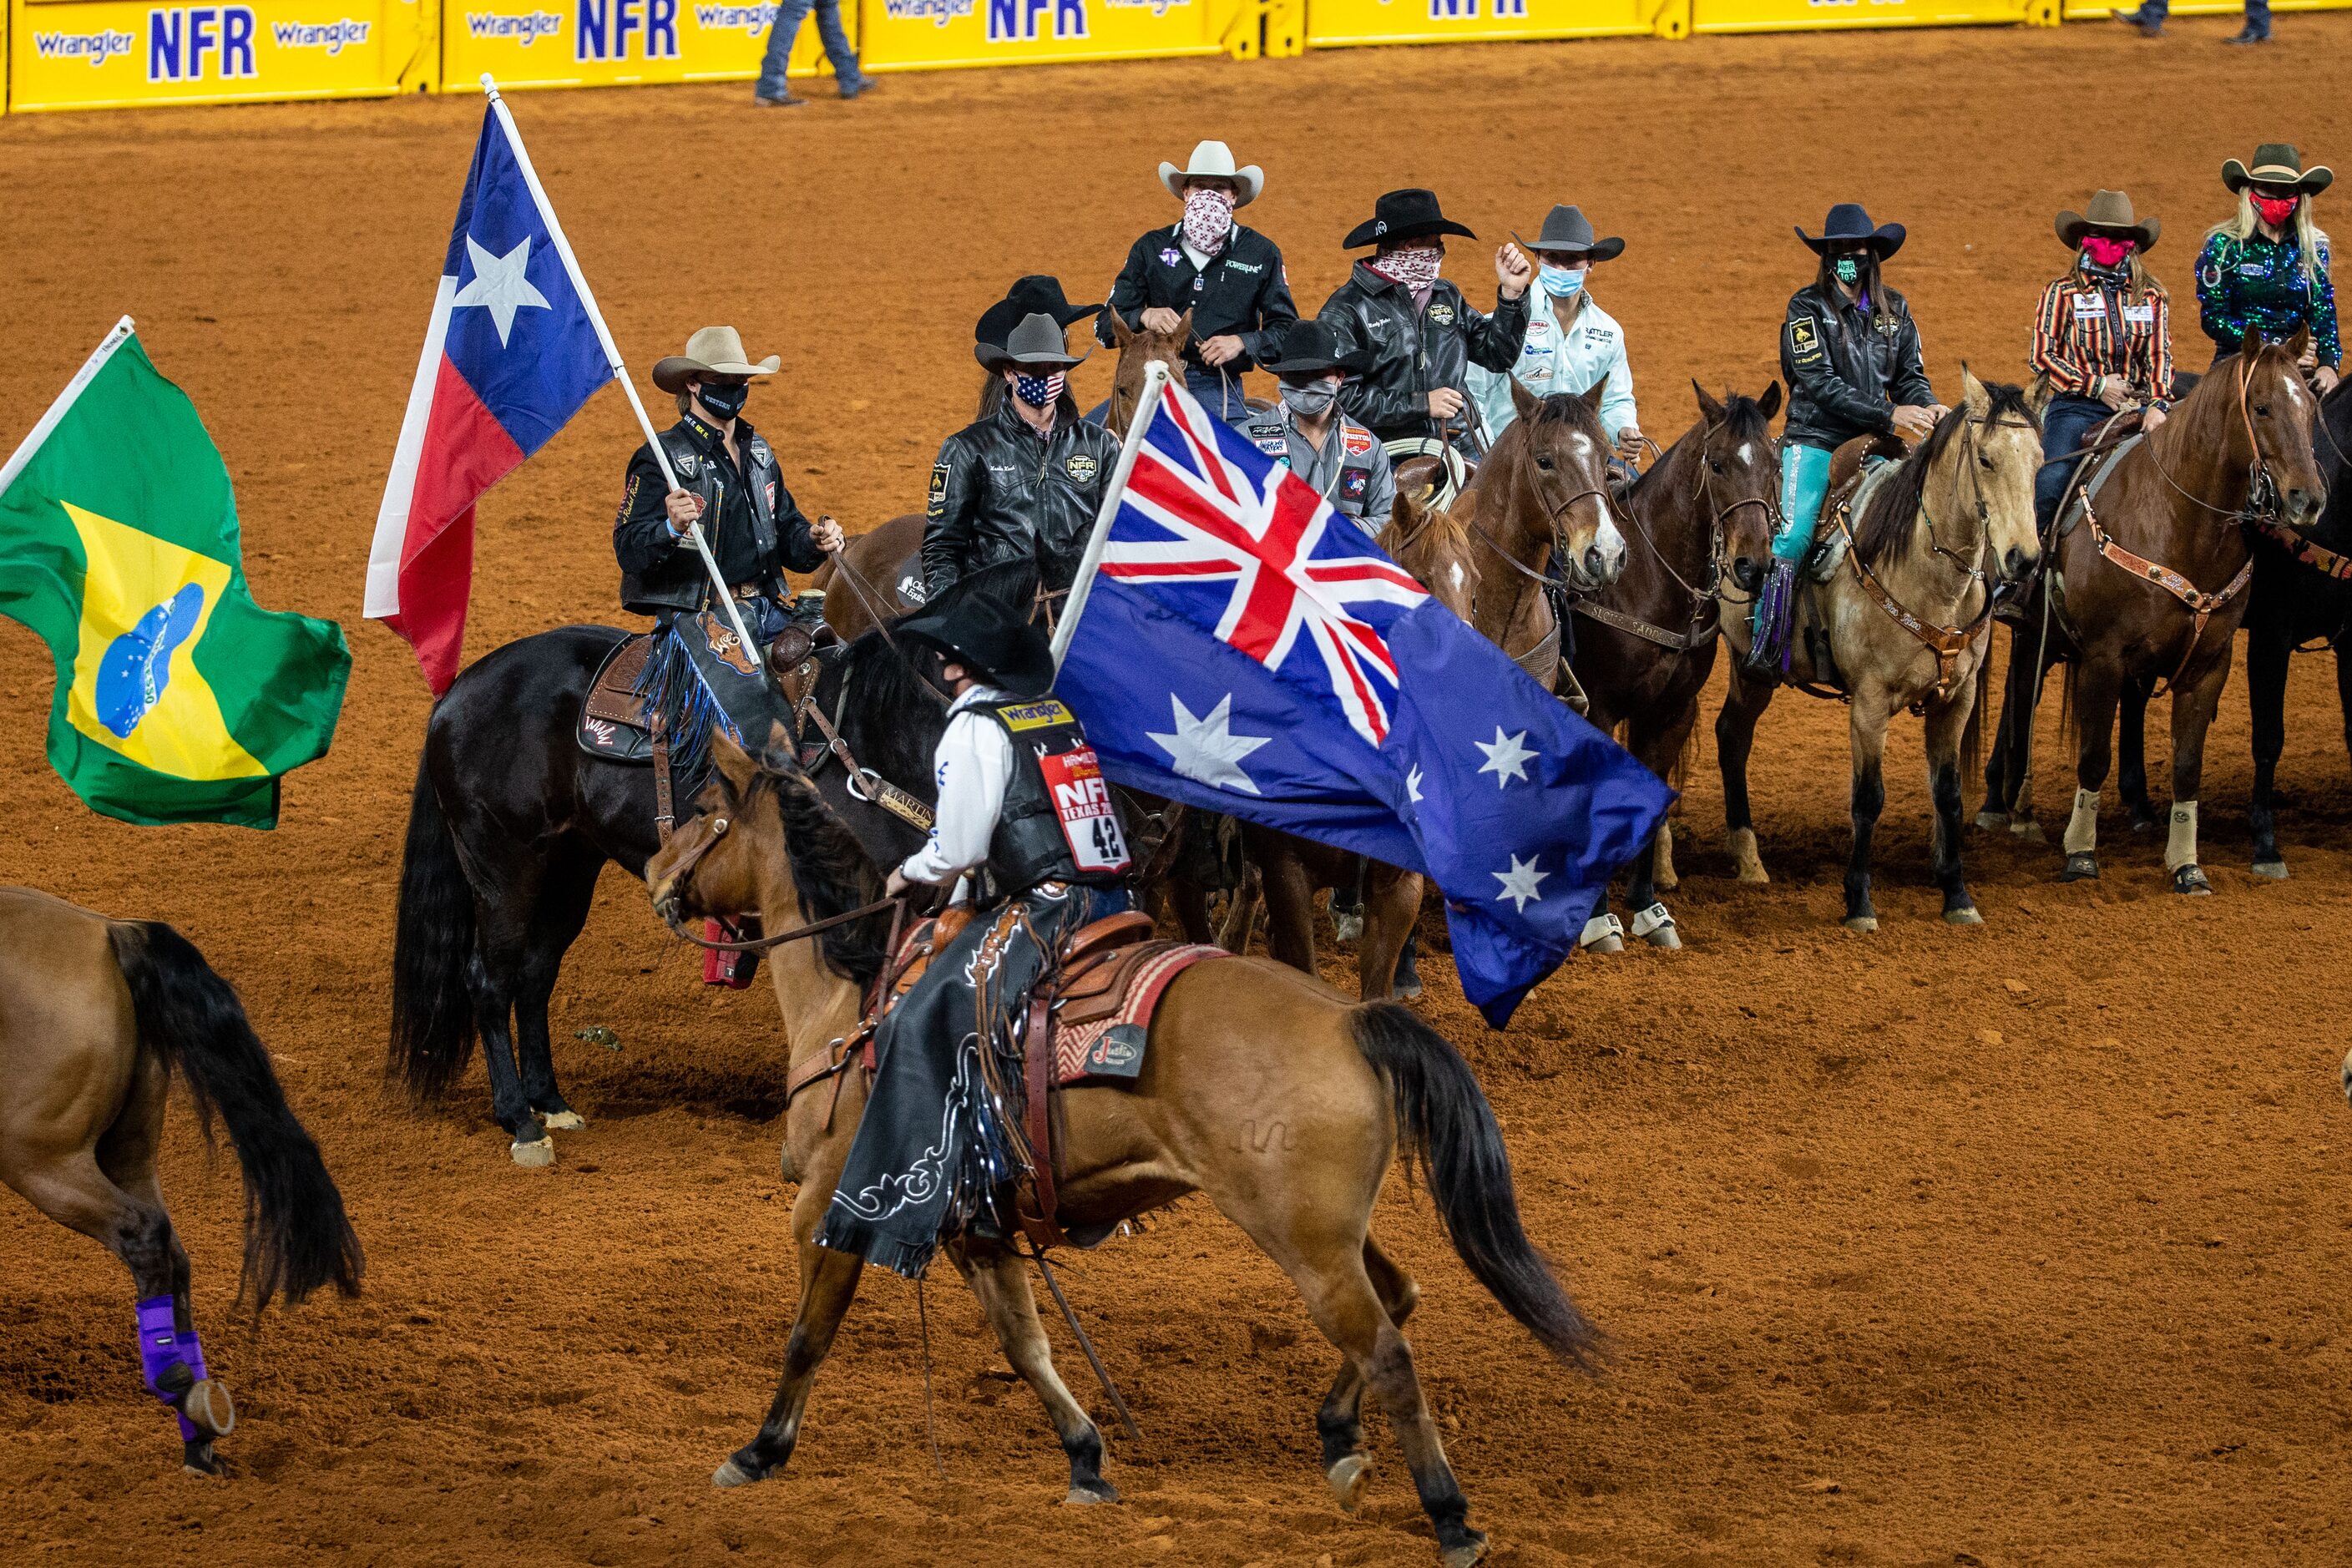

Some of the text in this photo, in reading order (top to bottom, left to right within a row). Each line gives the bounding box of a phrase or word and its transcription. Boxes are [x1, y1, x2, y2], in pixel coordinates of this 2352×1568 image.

[468, 0, 780, 59] Wrangler NFR Wrangle
[35, 10, 370, 80] Wrangler NFR Wrangler
[1430, 307, 1450, 316] NFR
[705, 394, 731, 411] WESTERN
[1069, 461, 1095, 470] NFR
[1002, 701, 1064, 723] Wrangler
[1061, 802, 1100, 822] TEXAS
[1092, 817, 1122, 858] 42
